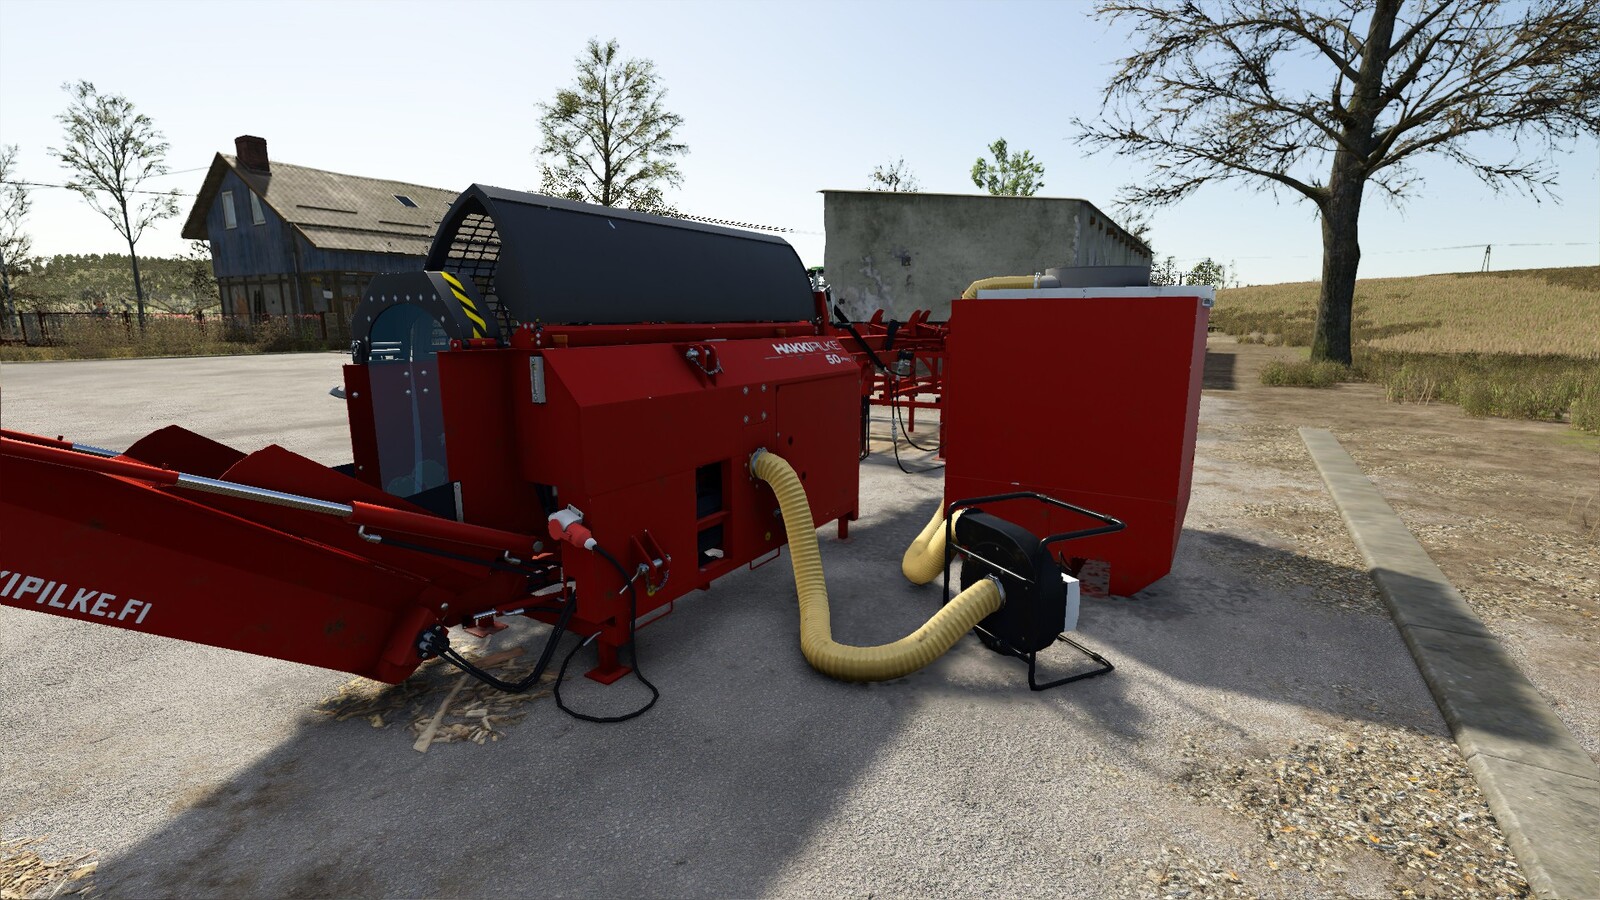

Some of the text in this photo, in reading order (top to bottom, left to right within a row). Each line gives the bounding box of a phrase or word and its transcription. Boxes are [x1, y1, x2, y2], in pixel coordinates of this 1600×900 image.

[772, 340, 842, 355] HAKKIPILKE
[825, 353, 842, 365] 50
[0, 570, 153, 624] IPILKE.FI
